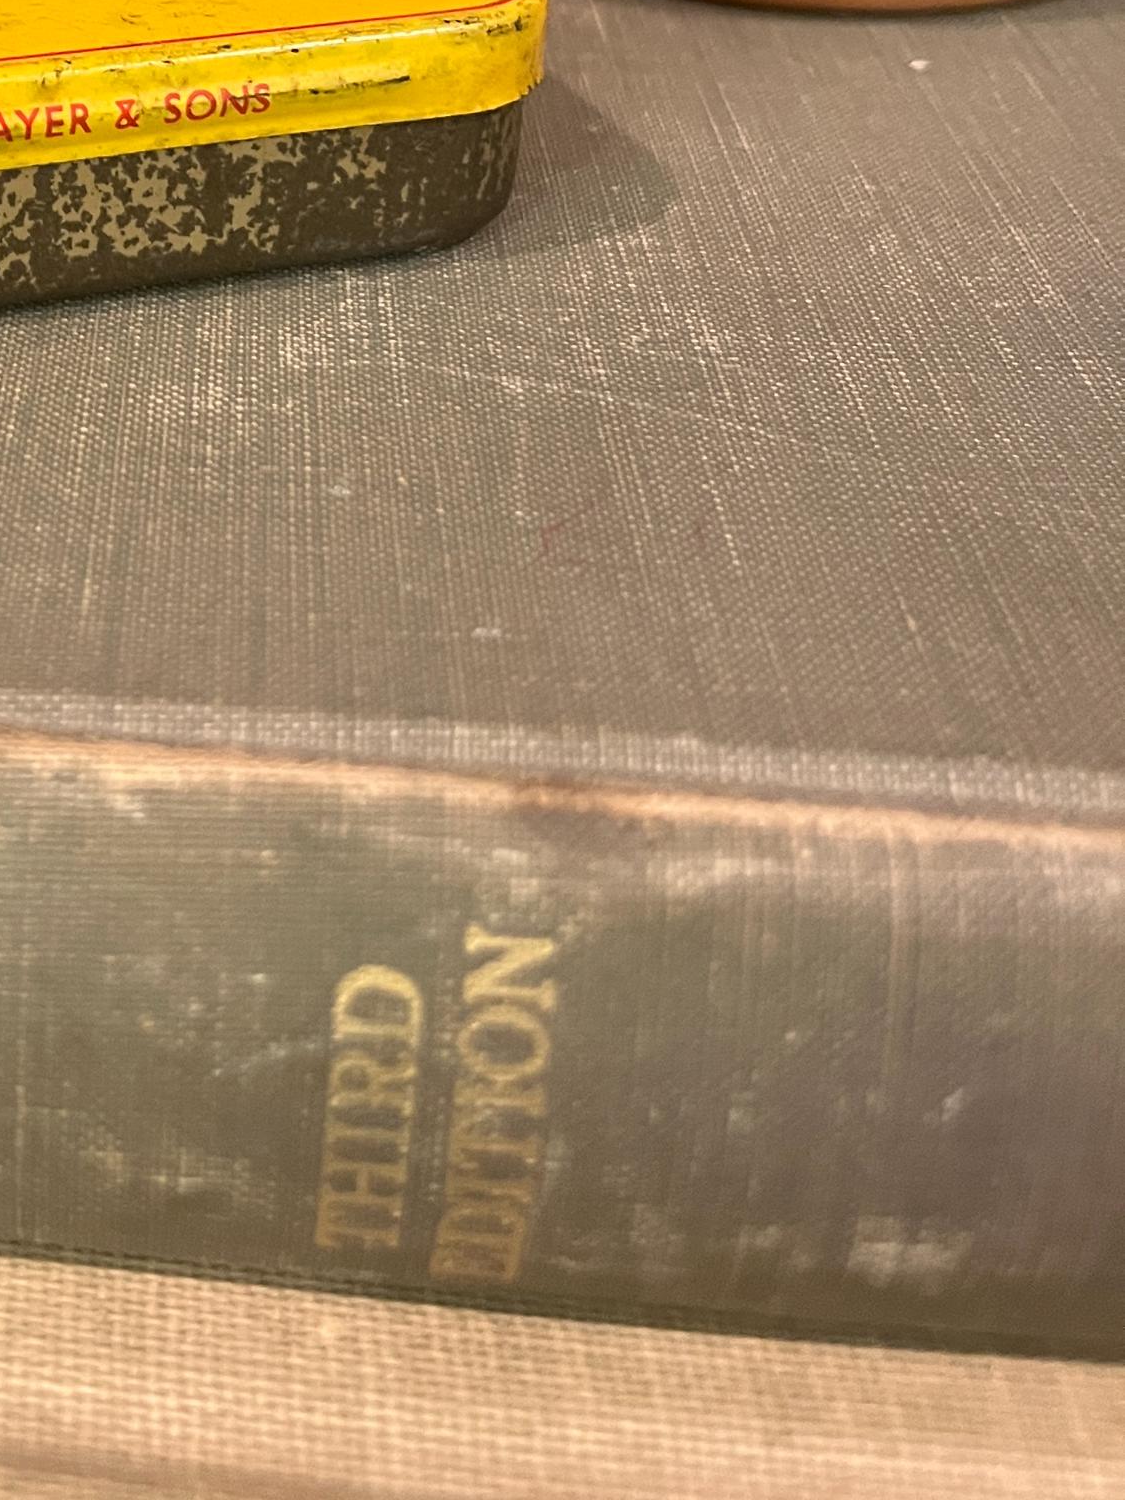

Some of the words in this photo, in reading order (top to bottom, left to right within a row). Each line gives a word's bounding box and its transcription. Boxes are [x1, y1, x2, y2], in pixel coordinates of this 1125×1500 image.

[114, 99, 140, 130] &
[163, 82, 272, 125] SONS
[315, 963, 424, 1248] THIRD
